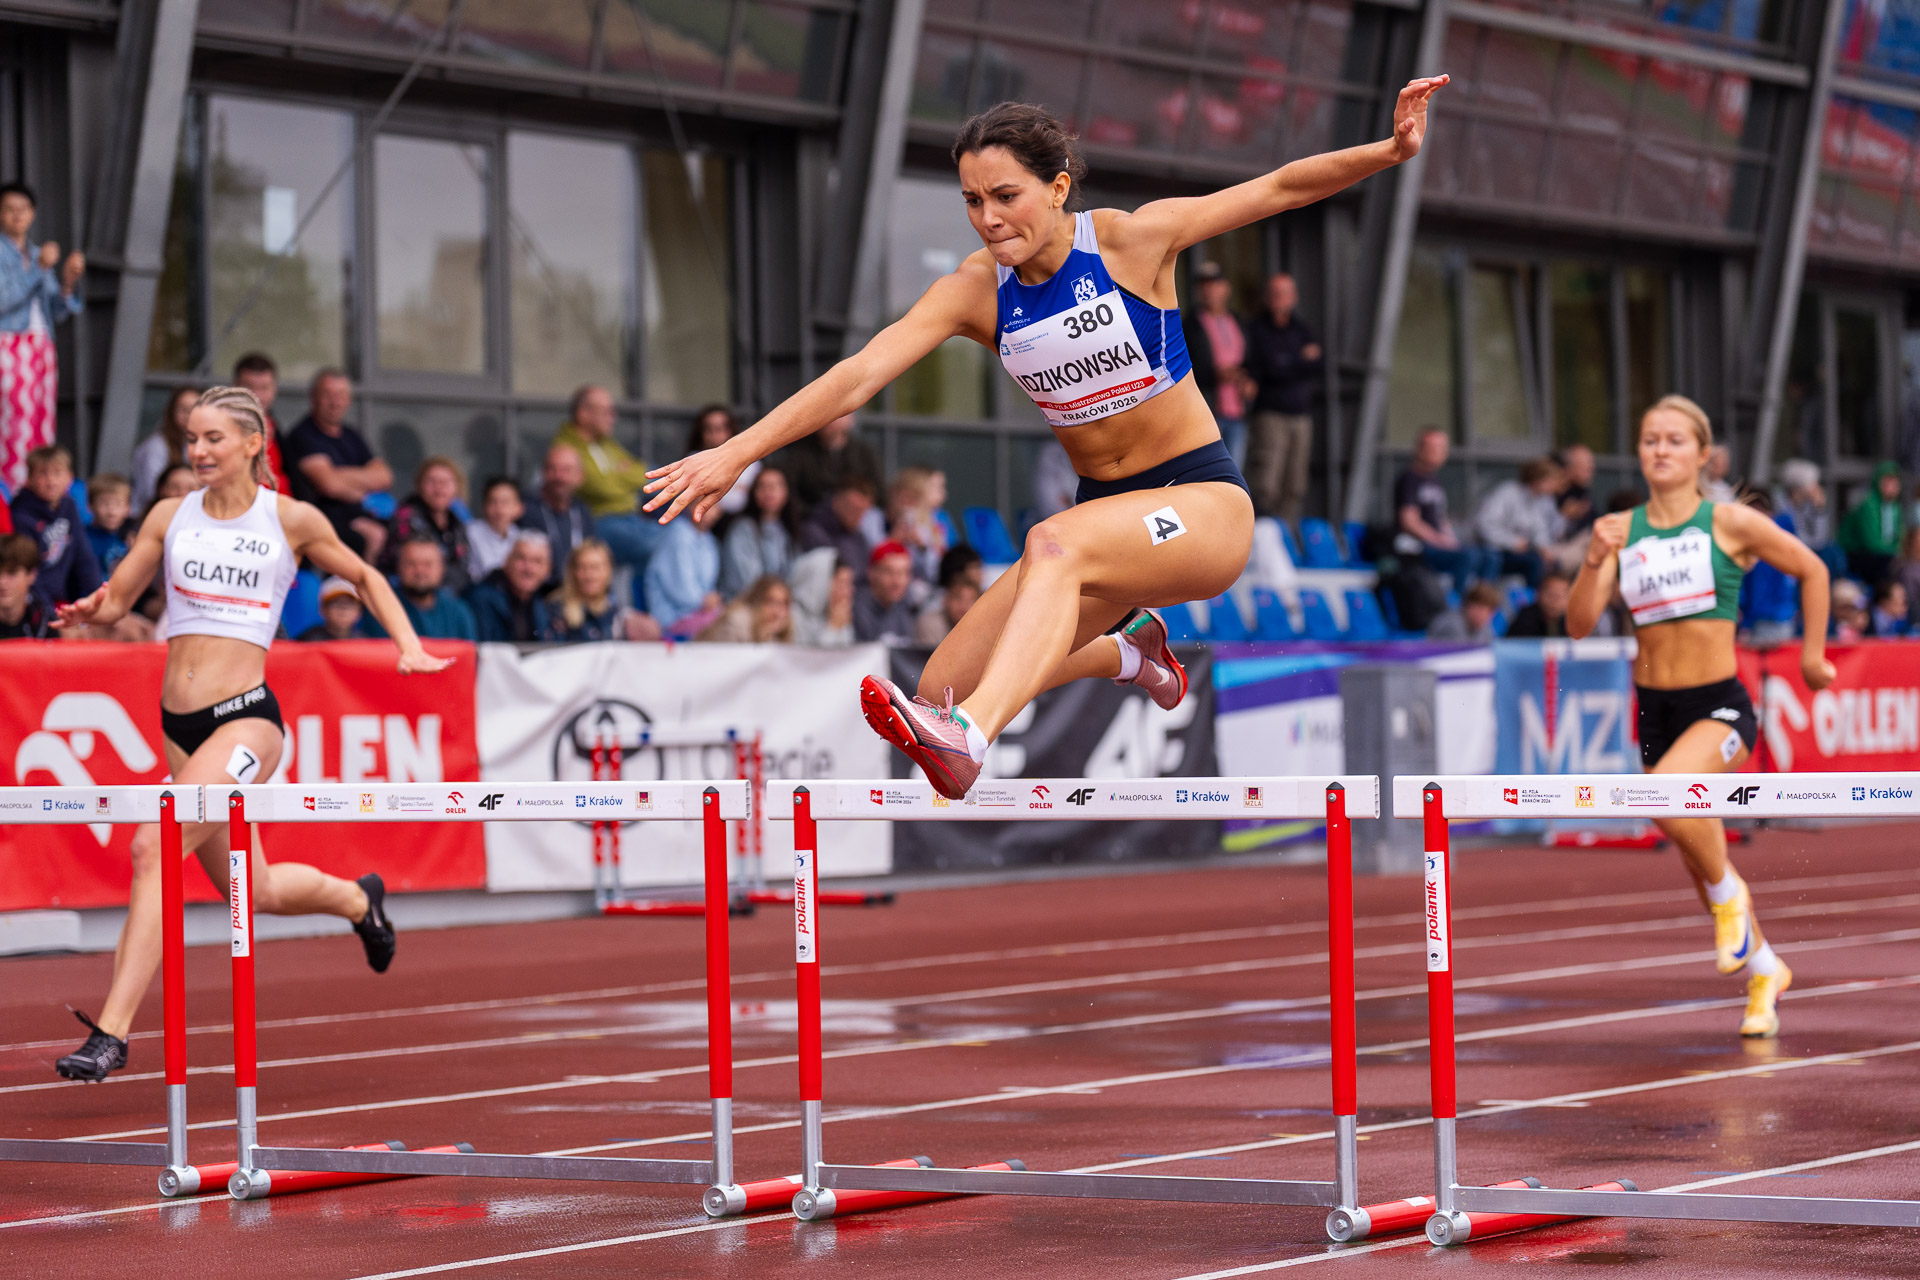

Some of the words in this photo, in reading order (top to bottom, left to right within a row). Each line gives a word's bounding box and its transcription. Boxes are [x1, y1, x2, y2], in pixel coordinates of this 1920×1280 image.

[1063, 303, 1114, 339] 380
[1016, 341, 1143, 393] IDZIKOWSKA
[1069, 391, 1111, 410] Mistrzostwa
[1111, 383, 1131, 396] Polski
[1131, 380, 1145, 390] U23
[1061, 403, 1109, 421] KRAKÓW
[1110, 396, 1138, 410] 2026
[1154, 517, 1179, 540] 4
[233, 537, 270, 556] 240
[183, 560, 259, 588] GLATKI
[1639, 568, 1693, 596] JANIK
[213, 695, 244, 718] NIKE
[244, 686, 267, 707] PRO
[238, 751, 256, 777] 7
[55, 800, 85, 810] Kraków
[478, 793, 504, 811] 4F
[589, 796, 623, 806] Kraków
[1066, 788, 1096, 806] 4F
[1192, 790, 1230, 802] Kraków
[1726, 786, 1760, 806] 4F
[1786, 792, 1837, 800] MAŁOPOLSKA
[1870, 787, 1913, 799] Kraków
[230, 876, 243, 930] polanik
[795, 877, 810, 934] polanik
[1426, 880, 1442, 941] polanik
